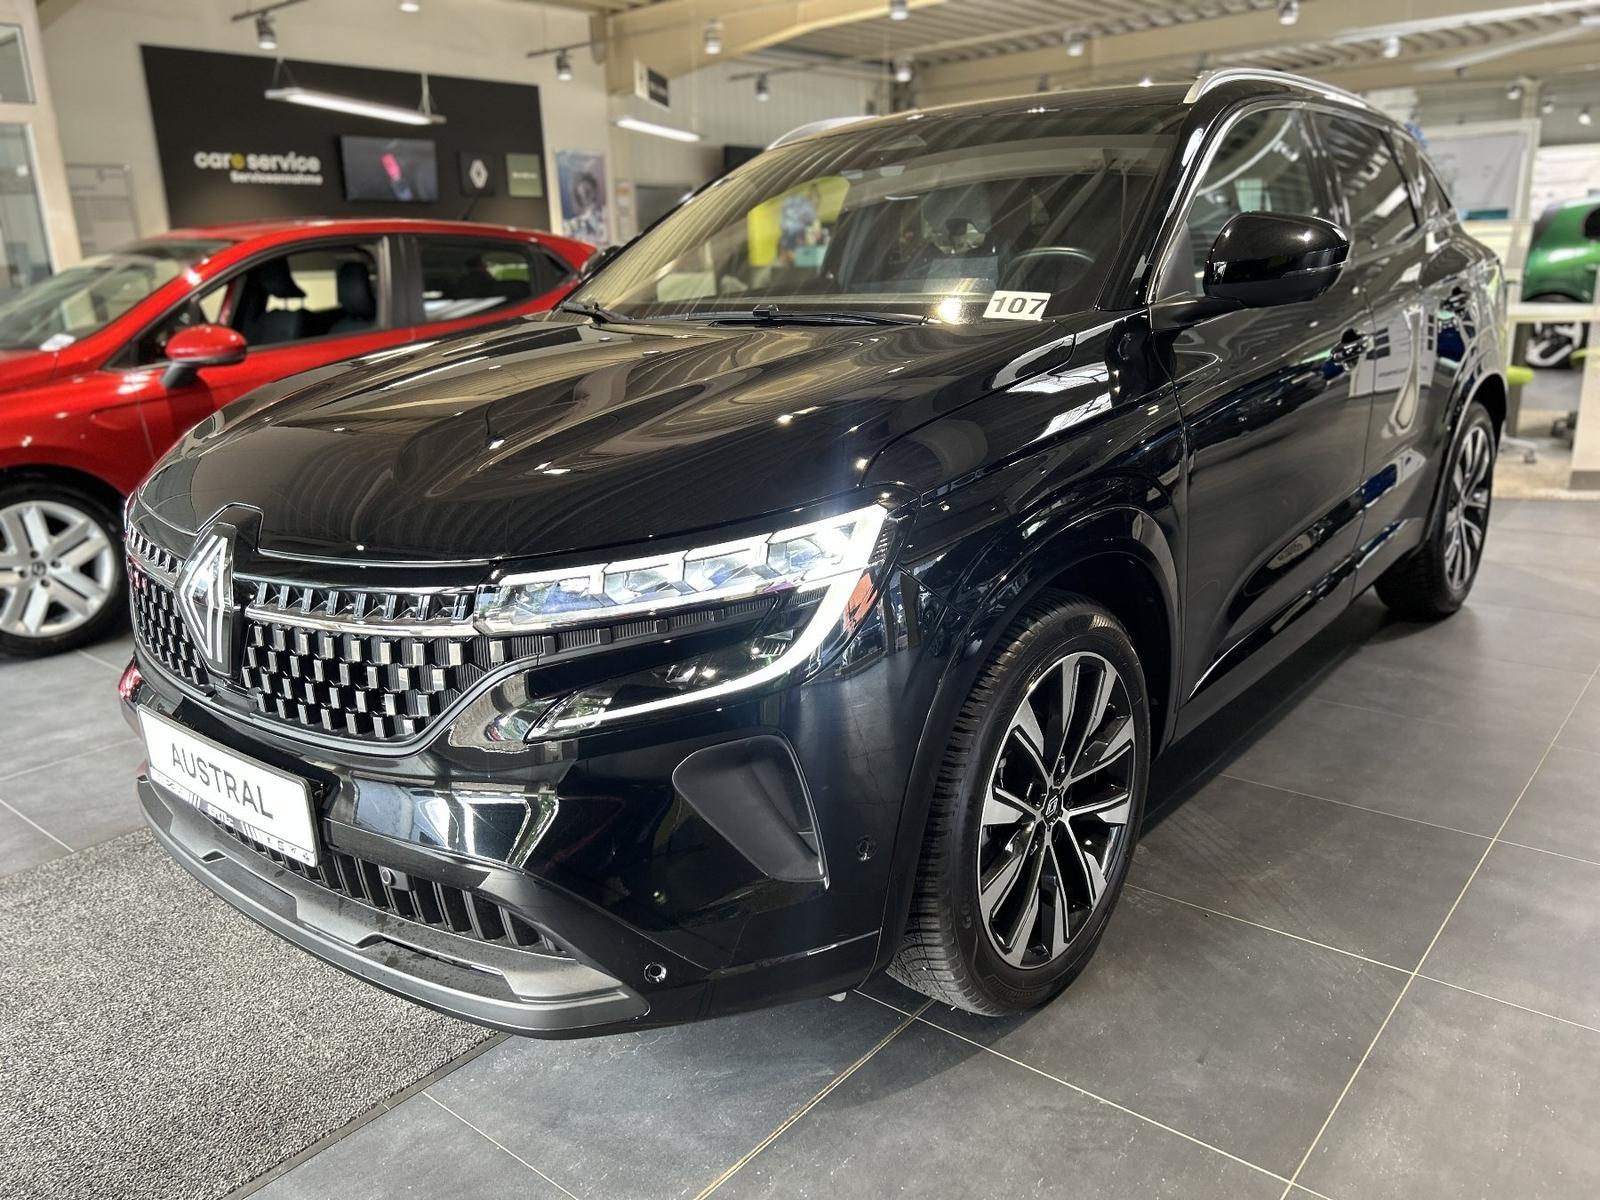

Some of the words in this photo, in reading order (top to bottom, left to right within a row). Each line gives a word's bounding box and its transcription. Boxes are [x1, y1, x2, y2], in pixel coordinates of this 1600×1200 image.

[247, 150, 321, 173] service
[993, 296, 1048, 315] 107
[171, 743, 274, 820] AUSTRAL
